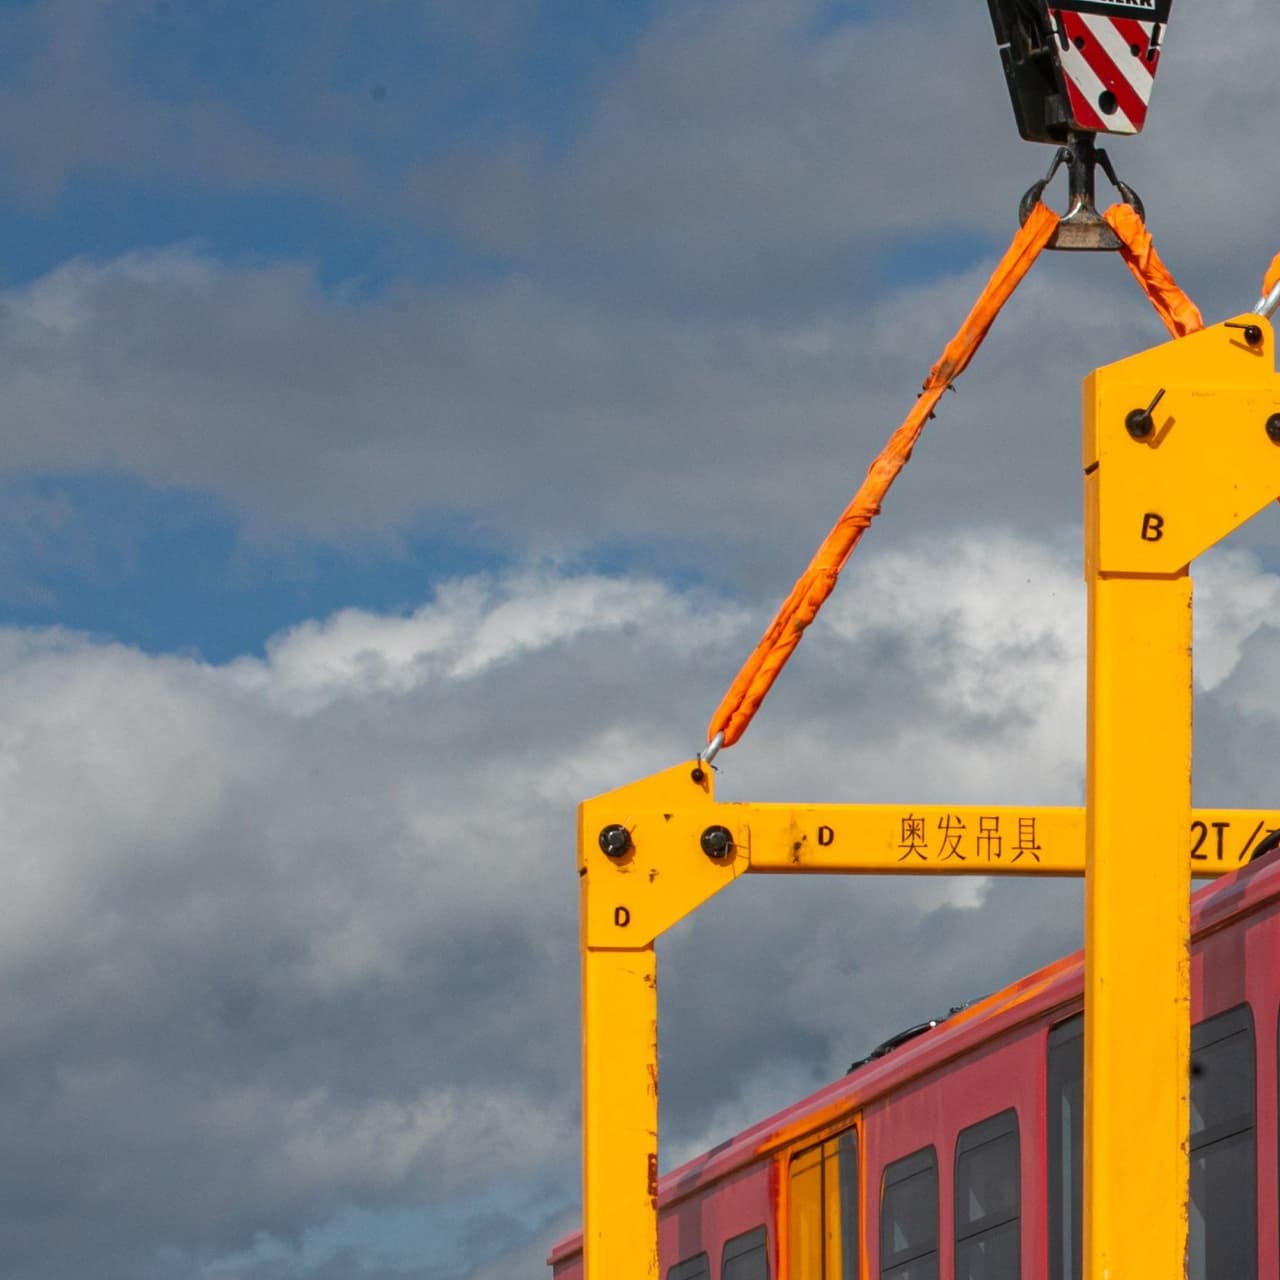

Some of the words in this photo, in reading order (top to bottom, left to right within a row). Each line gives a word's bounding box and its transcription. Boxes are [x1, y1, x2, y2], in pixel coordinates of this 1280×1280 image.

[1141, 512, 1165, 542] B
[817, 826, 834, 846] D
[897, 812, 1042, 863] 奥发吊具
[614, 906, 631, 927] D
